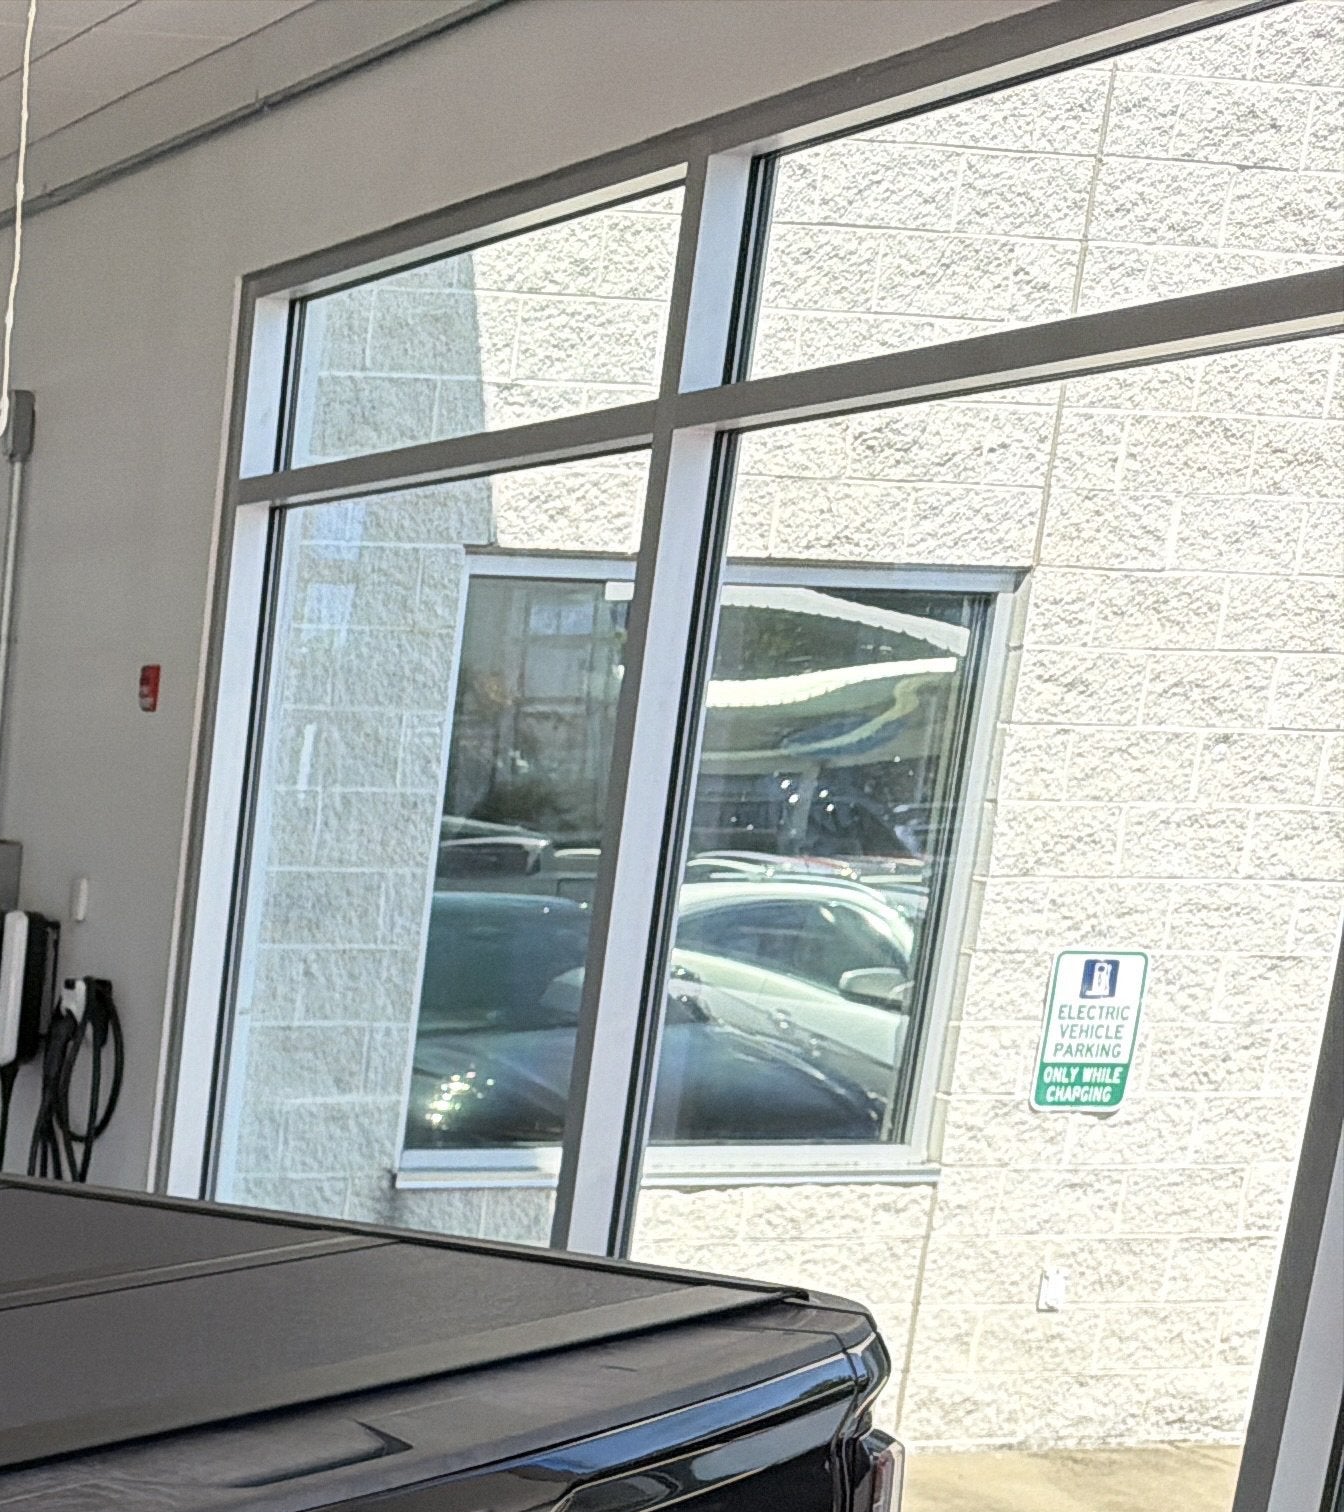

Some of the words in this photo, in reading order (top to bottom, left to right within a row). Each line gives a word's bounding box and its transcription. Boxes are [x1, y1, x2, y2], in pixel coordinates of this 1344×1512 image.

[1058, 1005, 1130, 1020] ELECTRIC
[1060, 1024, 1124, 1040] VEHICLE
[1053, 1043, 1121, 1058] PARKING
[1043, 1066, 1079, 1083] ONLY
[1082, 1066, 1123, 1083] WHILE
[1046, 1085, 1111, 1103] CHARGING
